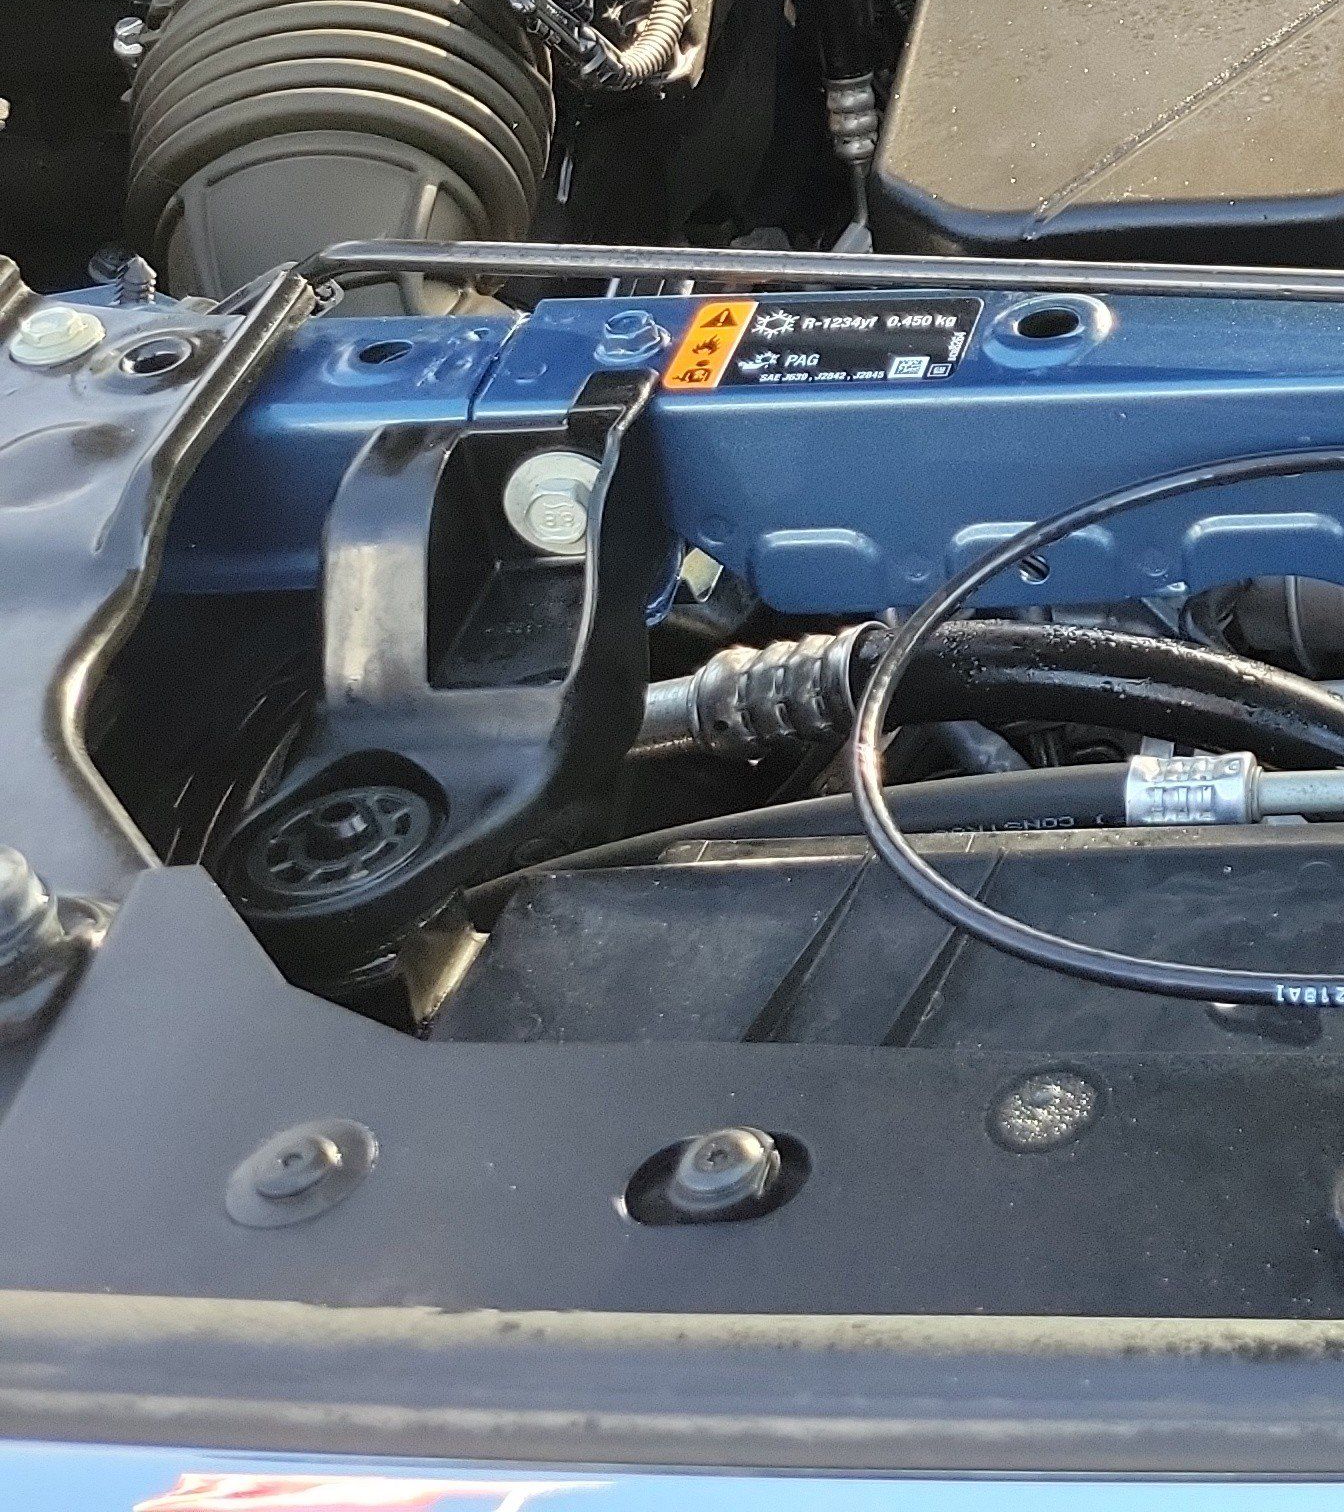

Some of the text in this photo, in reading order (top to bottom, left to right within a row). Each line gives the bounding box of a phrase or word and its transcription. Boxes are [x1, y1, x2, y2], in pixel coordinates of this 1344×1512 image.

[802, 314, 957, 330] R-1234yf 0.450 kg
[785, 353, 820, 367] PAG
[759, 372, 780, 382] SAE
